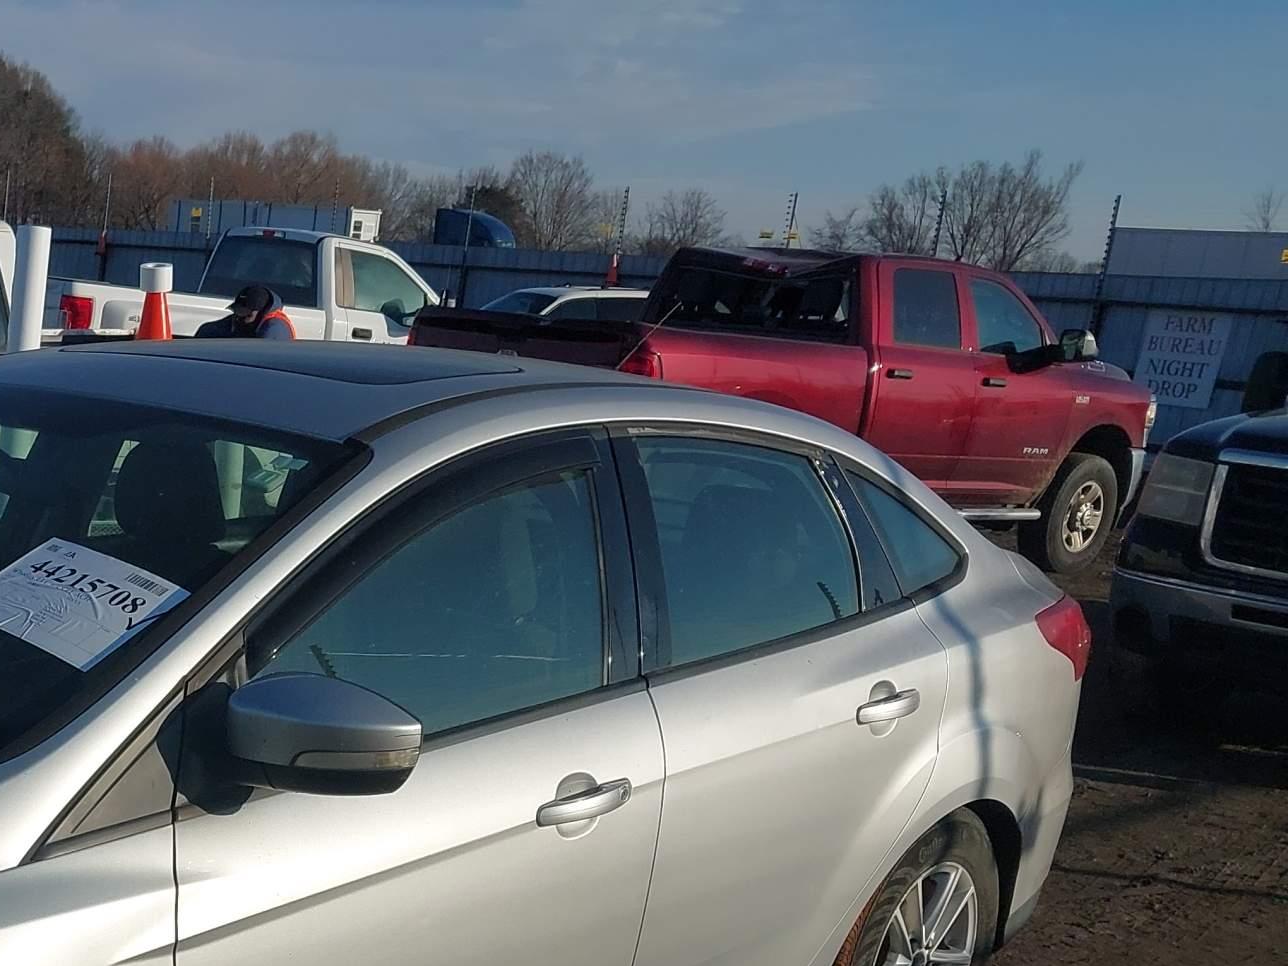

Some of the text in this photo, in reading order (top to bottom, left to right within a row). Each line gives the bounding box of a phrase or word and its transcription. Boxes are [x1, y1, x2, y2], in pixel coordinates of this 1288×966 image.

[1164, 314, 1216, 334] FARM
[1147, 336, 1223, 355] BUREAU
[1146, 358, 1211, 379] NIGHT
[1148, 379, 1199, 400] DROP
[1022, 447, 1049, 455] RAM
[30, 560, 146, 614] 44215708
